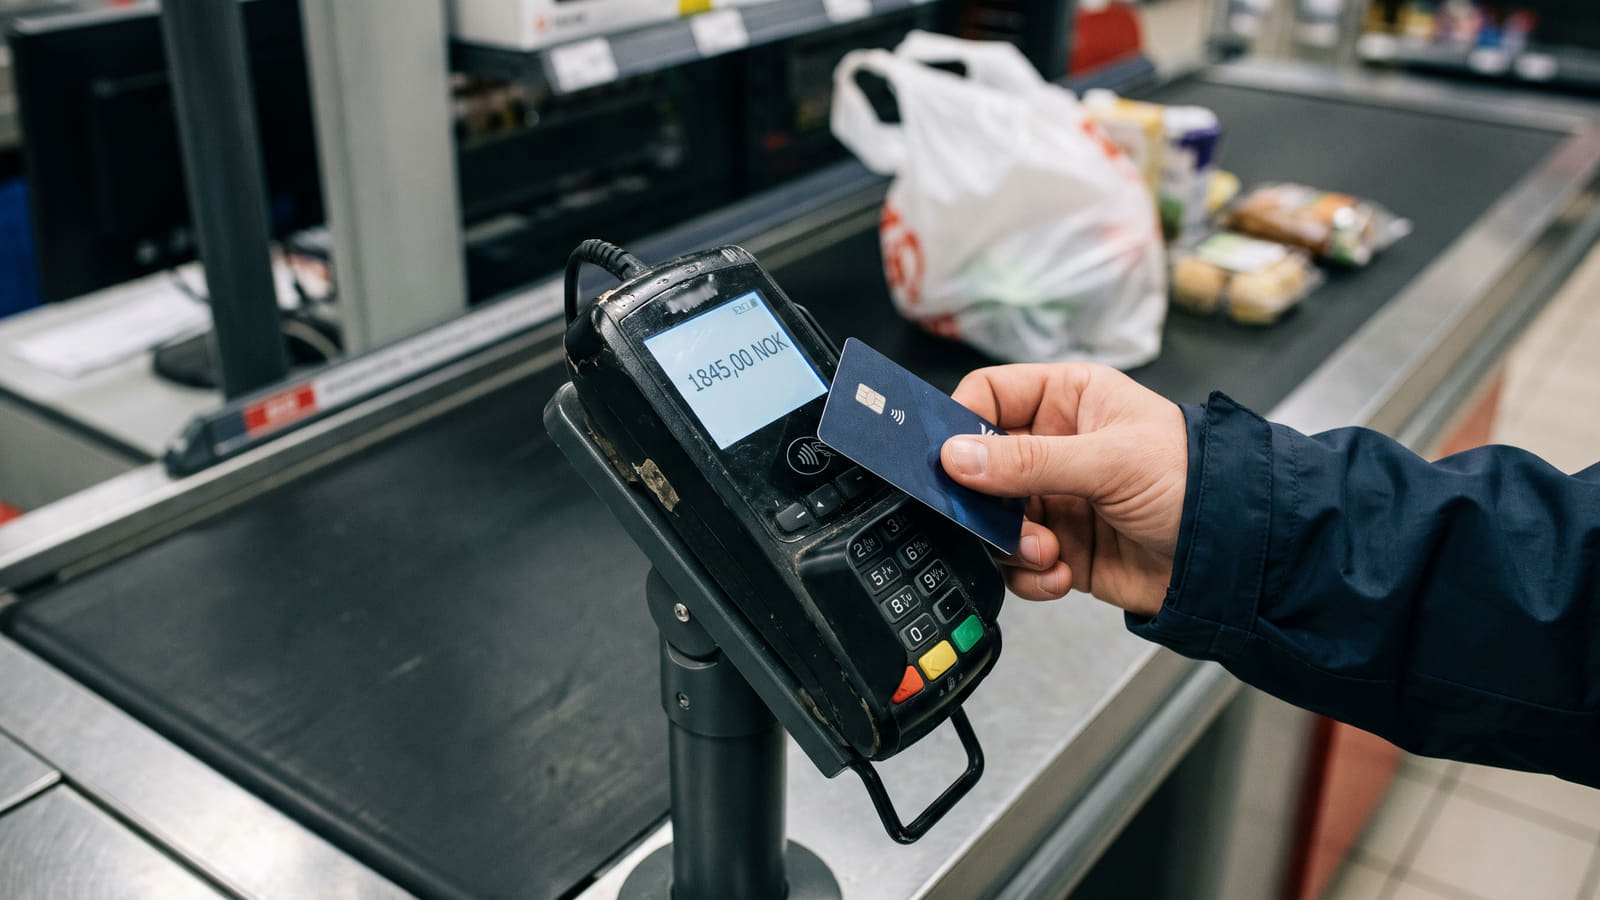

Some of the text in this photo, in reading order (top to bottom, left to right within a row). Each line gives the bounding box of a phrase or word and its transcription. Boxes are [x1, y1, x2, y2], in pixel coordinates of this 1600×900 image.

[688, 332, 790, 392] 1845,00 NOK
[887, 518, 900, 533] 3
[853, 543, 867, 558] 2
[905, 546, 918, 561] 6
[870, 570, 884, 586] 5
[923, 573, 936, 589] 9
[891, 598, 904, 614] 8
[910, 627, 923, 642] 0
